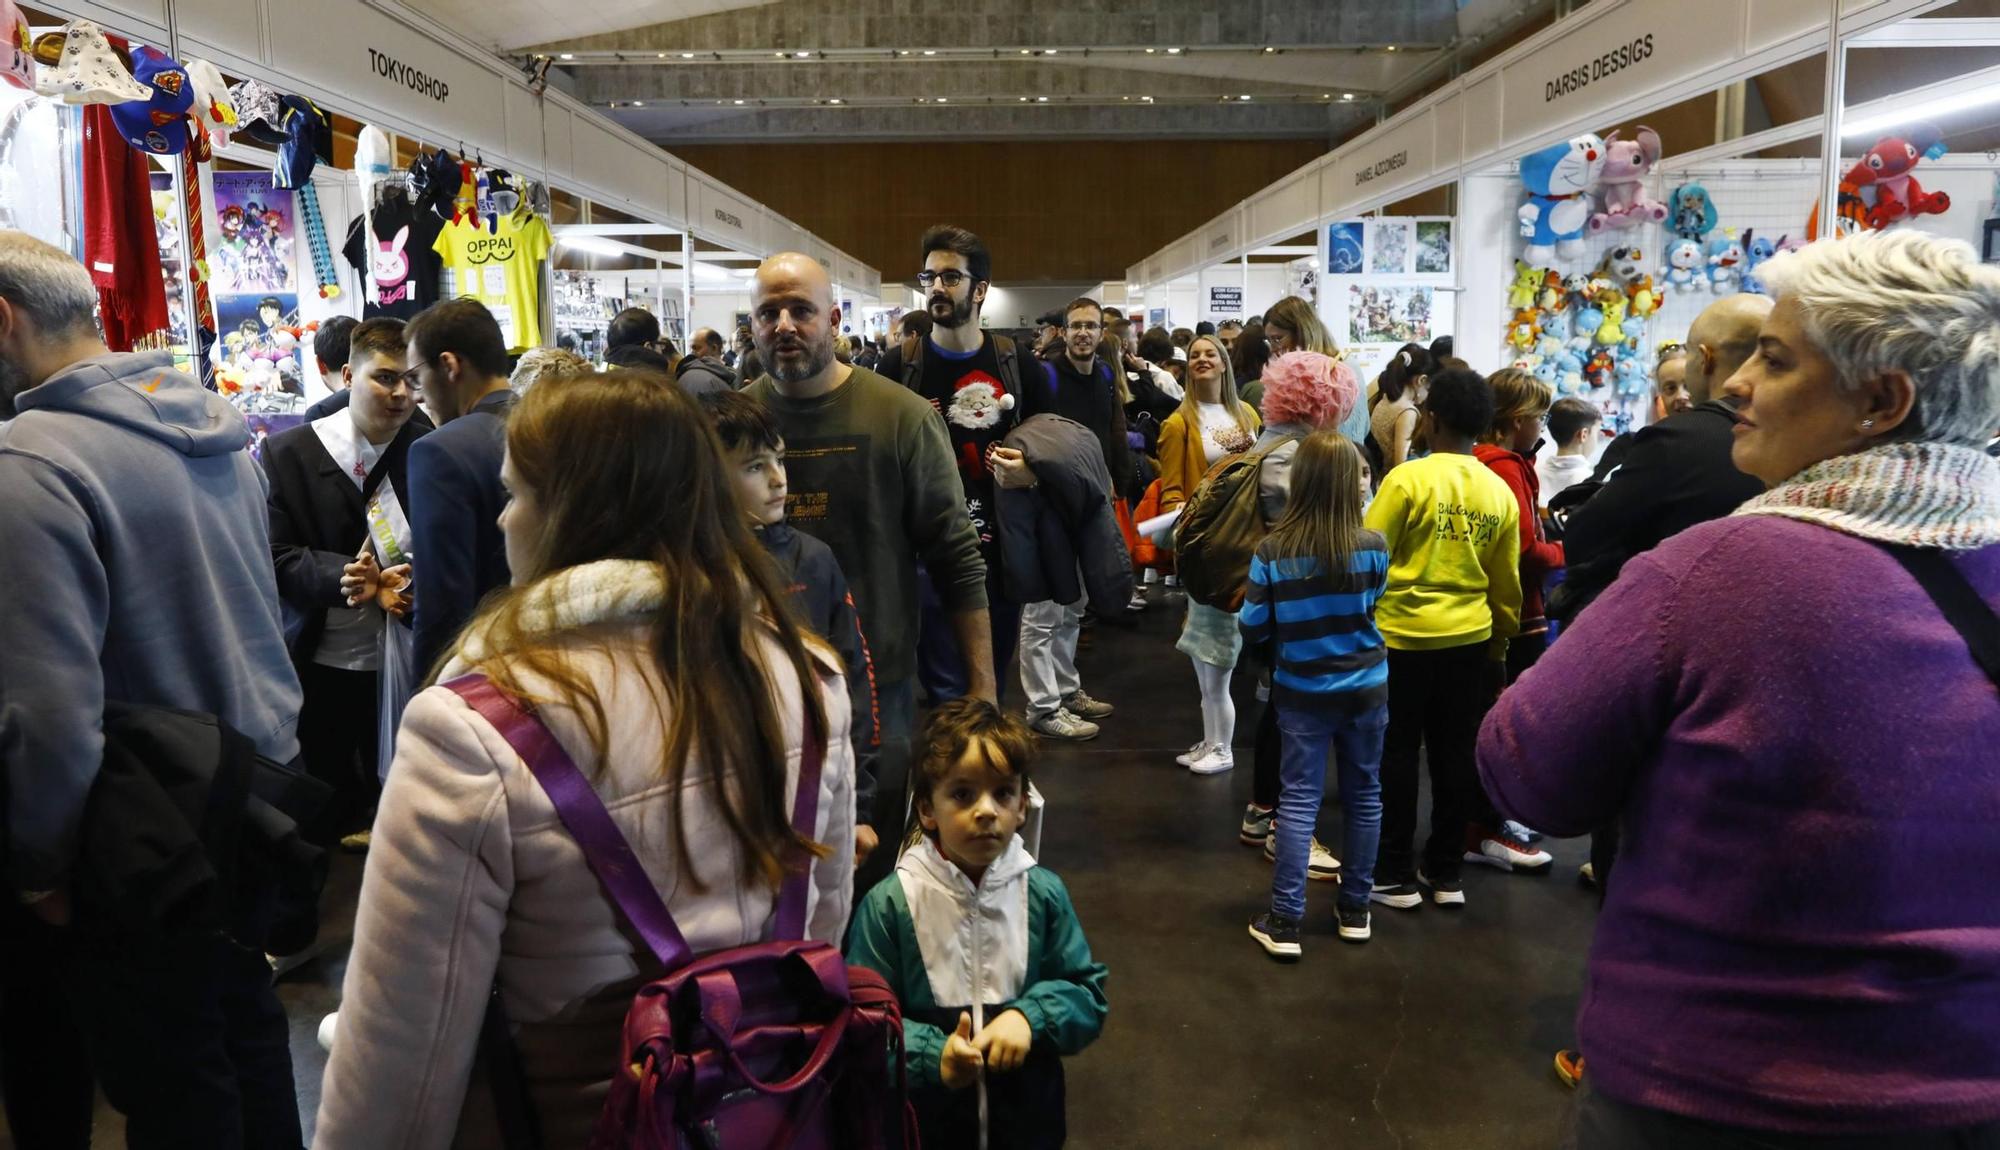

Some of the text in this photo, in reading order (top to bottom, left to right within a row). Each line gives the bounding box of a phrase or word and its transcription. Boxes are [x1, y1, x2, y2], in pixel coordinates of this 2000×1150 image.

[368, 47, 449, 103] TOKYOSHOP
[1546, 33, 1653, 102] DARSIS DESSIGS
[467, 237, 512, 253] OPPAI
